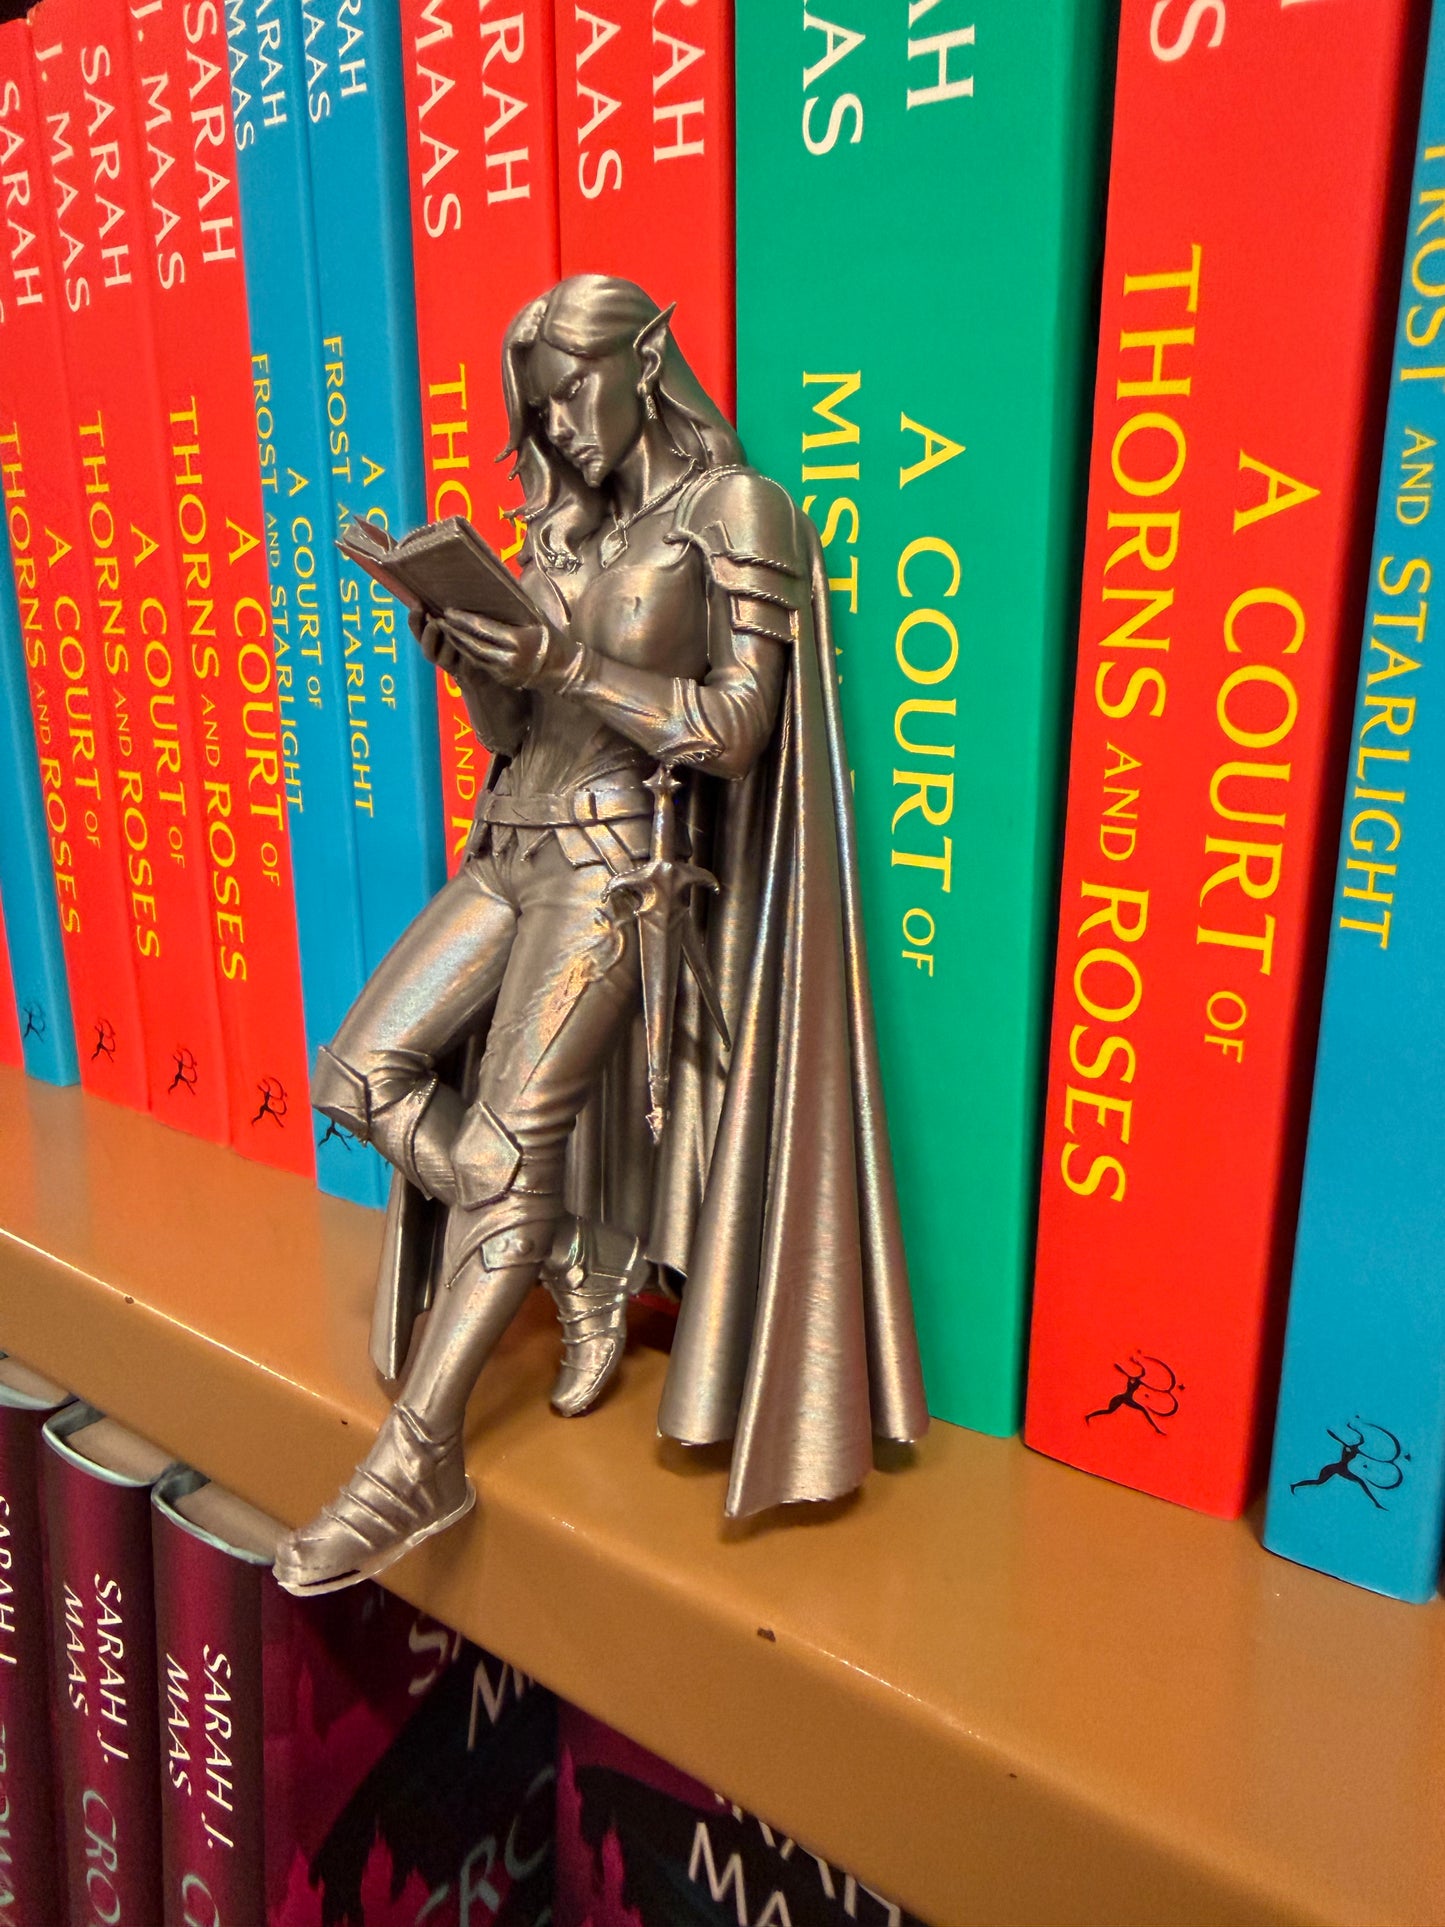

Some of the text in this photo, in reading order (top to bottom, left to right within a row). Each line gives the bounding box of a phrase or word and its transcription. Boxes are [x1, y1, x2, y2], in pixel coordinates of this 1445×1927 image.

[80, 44, 133, 288] SARAH
[141, 71, 186, 290] MAAS
[183, 0, 237, 263] SARAH
[300, 0, 331, 124] AAS
[479, 0, 531, 206] RAH
[0, 80, 43, 306] SARAH
[46, 111, 91, 313] MAAS
[250, 353, 304, 814] FROST AND STARLIGHT
[287, 467, 324, 710] A COURT OF
[322, 336, 352, 483] FROST
[338, 578, 374, 818] STARLIGHT
[360, 455, 397, 710] A CURT OF
[1395, 426, 1437, 526] AND
[0, 421, 81, 935] THORNS AND ROSES
[45, 525, 101, 849] A COURT OF
[78, 410, 161, 958] THORNS AND ROSES
[130, 523, 187, 870] A COURT OF
[169, 395, 248, 982] THORNS AND ROSES
[225, 516, 285, 888] A COURT OF
[453, 714, 477, 800] AND
[890, 410, 967, 978] A COURT OF
[1059, 242, 1203, 1203] THORNS AND ROSES
[1195, 447, 1322, 1065] A COURT OF
[1337, 554, 1432, 951] STARLIGHT
[63, 1580, 90, 1717] MAAS
[94, 1573, 130, 1764] SARAH J.
[165, 1652, 193, 1797] MAAS
[200, 1644, 236, 1850] SARAH J.
